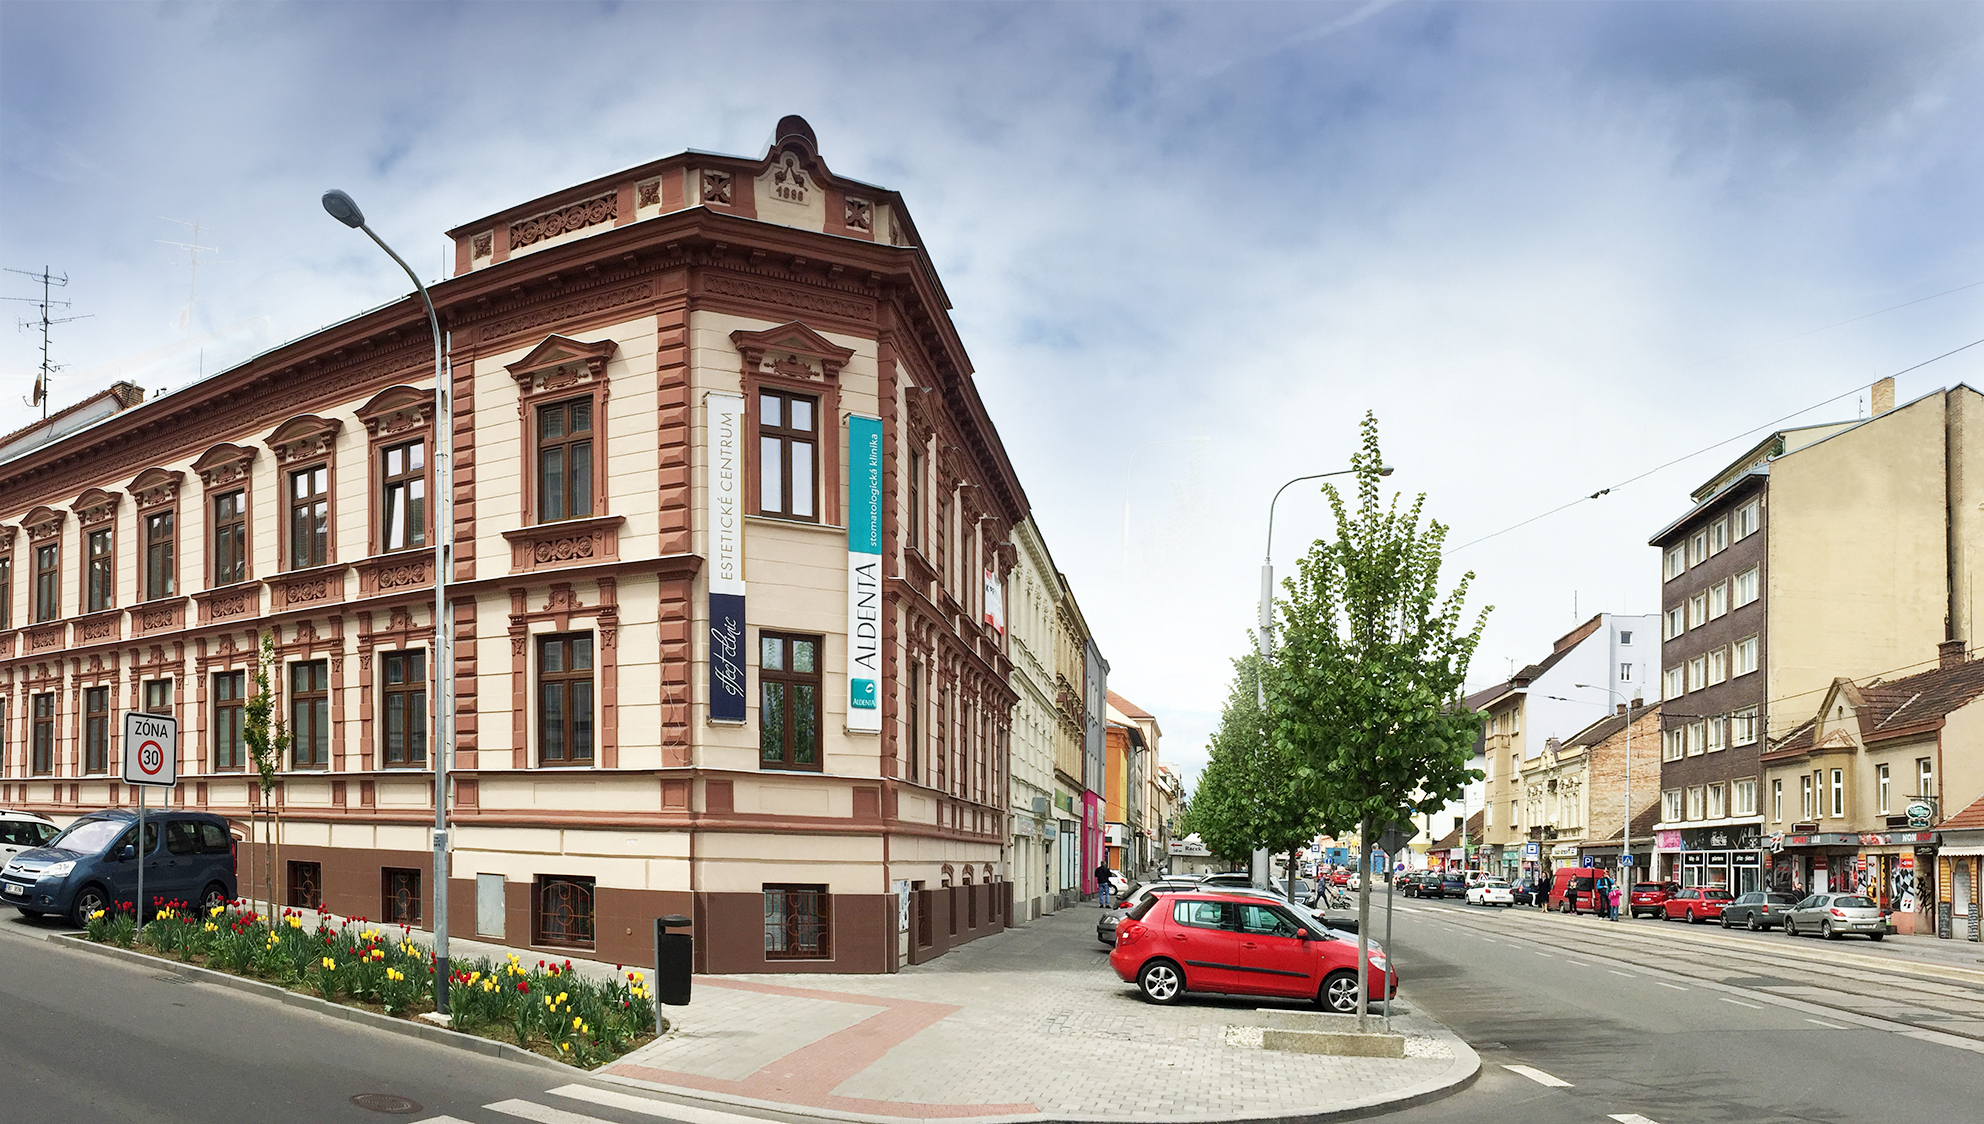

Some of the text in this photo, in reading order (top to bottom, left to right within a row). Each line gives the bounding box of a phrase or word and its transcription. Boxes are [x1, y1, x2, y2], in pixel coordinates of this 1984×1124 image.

[717, 412, 733, 580] ESTETICKÉ CENTRUM
[869, 433, 880, 547] stomatologická klinika
[855, 563, 877, 671] ALDENTA
[852, 698, 876, 707] ALDENTA
[135, 719, 168, 738] ZÓNA
[143, 749, 159, 766] 30
[1902, 832, 1932, 842] NONSTOP
